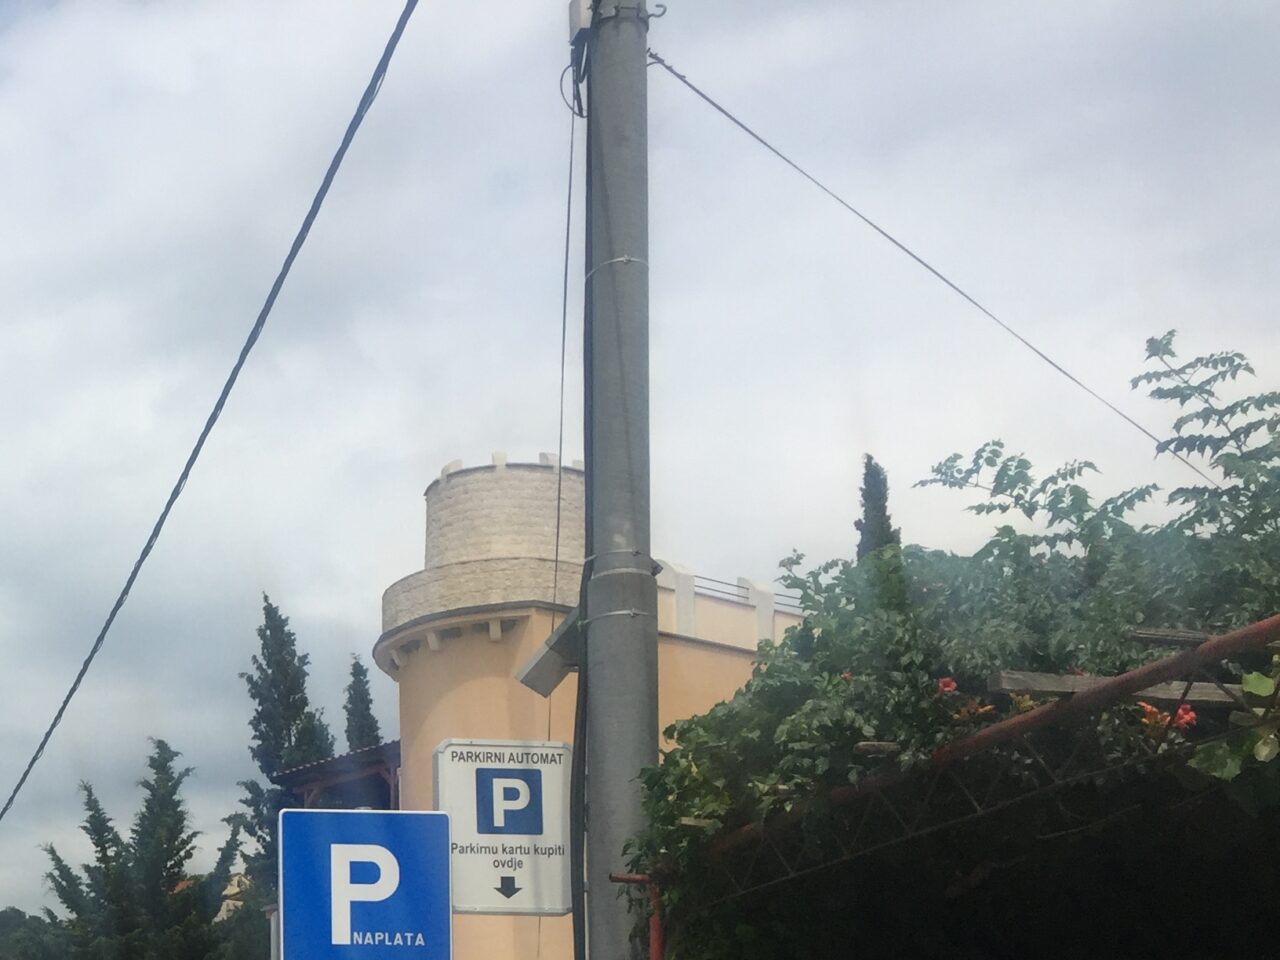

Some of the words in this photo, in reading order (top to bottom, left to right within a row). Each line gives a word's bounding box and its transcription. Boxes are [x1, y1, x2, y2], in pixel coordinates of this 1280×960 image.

[451, 751, 505, 763] PARKIRNI
[507, 753, 564, 765] AUTOMAT
[492, 778, 530, 827] P
[501, 844, 531, 855] kartu
[533, 844, 565, 858] kupiti
[492, 857, 524, 871] ovdje
[330, 843, 400, 945] P
[352, 932, 425, 946] NAPLATA
